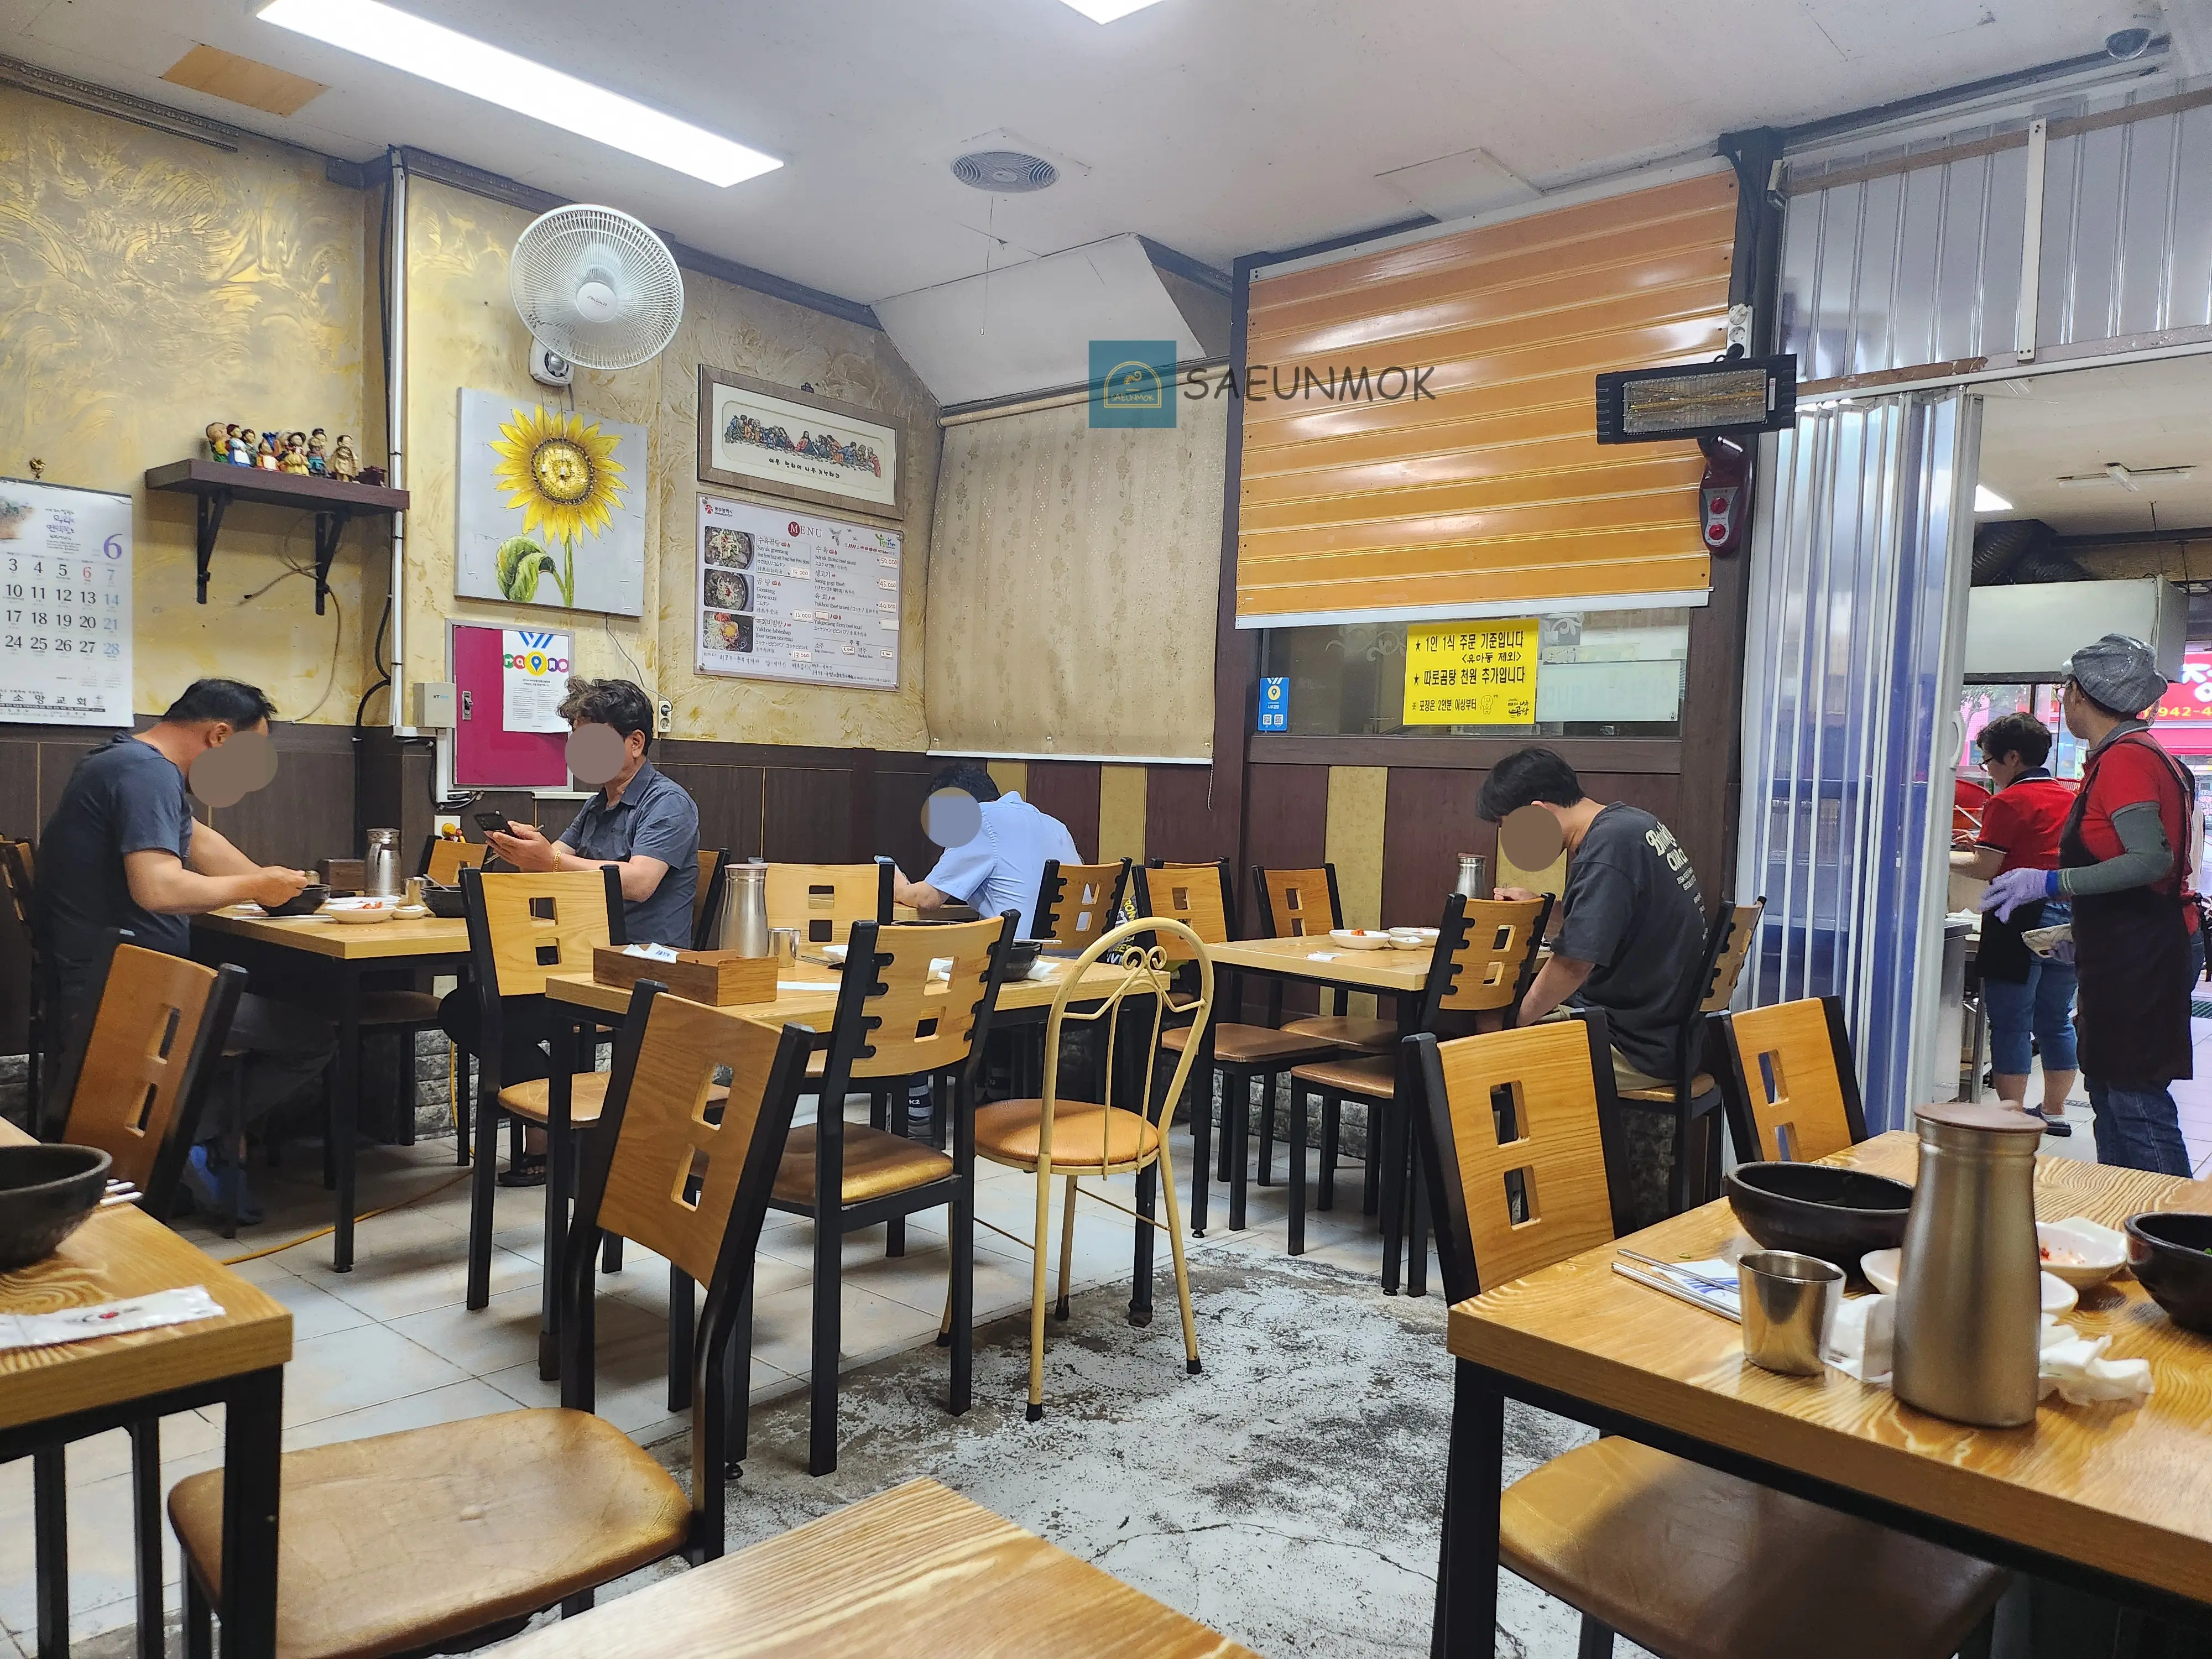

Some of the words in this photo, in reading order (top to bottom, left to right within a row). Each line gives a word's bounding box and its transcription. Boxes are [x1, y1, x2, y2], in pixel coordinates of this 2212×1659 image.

[790, 524, 822, 538] MENU
[103, 534, 122, 560] 6
[758, 536, 780, 547] 수육곰탕
[8, 559, 18, 571] 3
[34, 561, 43, 573] 4
[59, 564, 67, 576] 5
[83, 566, 91, 578] 6
[107, 569, 114, 581] 7
[815, 570, 830, 578] 생고기
[6, 584, 23, 597] 10
[31, 587, 45, 599] 11
[56, 589, 72, 602] 12
[80, 591, 96, 604] 13
[105, 593, 120, 606] 14
[6, 609, 22, 623] 17
[32, 612, 48, 625] 18
[56, 614, 72, 627] 19
[80, 615, 96, 629] 20
[103, 618, 118, 630] 21
[5, 635, 23, 648] 24
[30, 637, 48, 650] 25
[55, 639, 72, 651] 26
[80, 640, 96, 653] 27
[103, 643, 120, 655] 28
[1426, 636, 1438, 652] 1인
[1443, 634, 1455, 651] 1식
[1459, 634, 1476, 650] 주문
[1480, 630, 1524, 650] 기준입니다
[1462, 652, 1493, 664] <유아동
[1498, 651, 1522, 662] 제외>
[1423, 669, 1457, 686] 따로곰탕
[1460, 667, 1477, 685] 천원
[1481, 666, 1525, 684] 추가입니다
[1419, 700, 1435, 712] 포장은
[1437, 699, 1452, 711] 2인분
[1454, 698, 1477, 711] 이상부터
